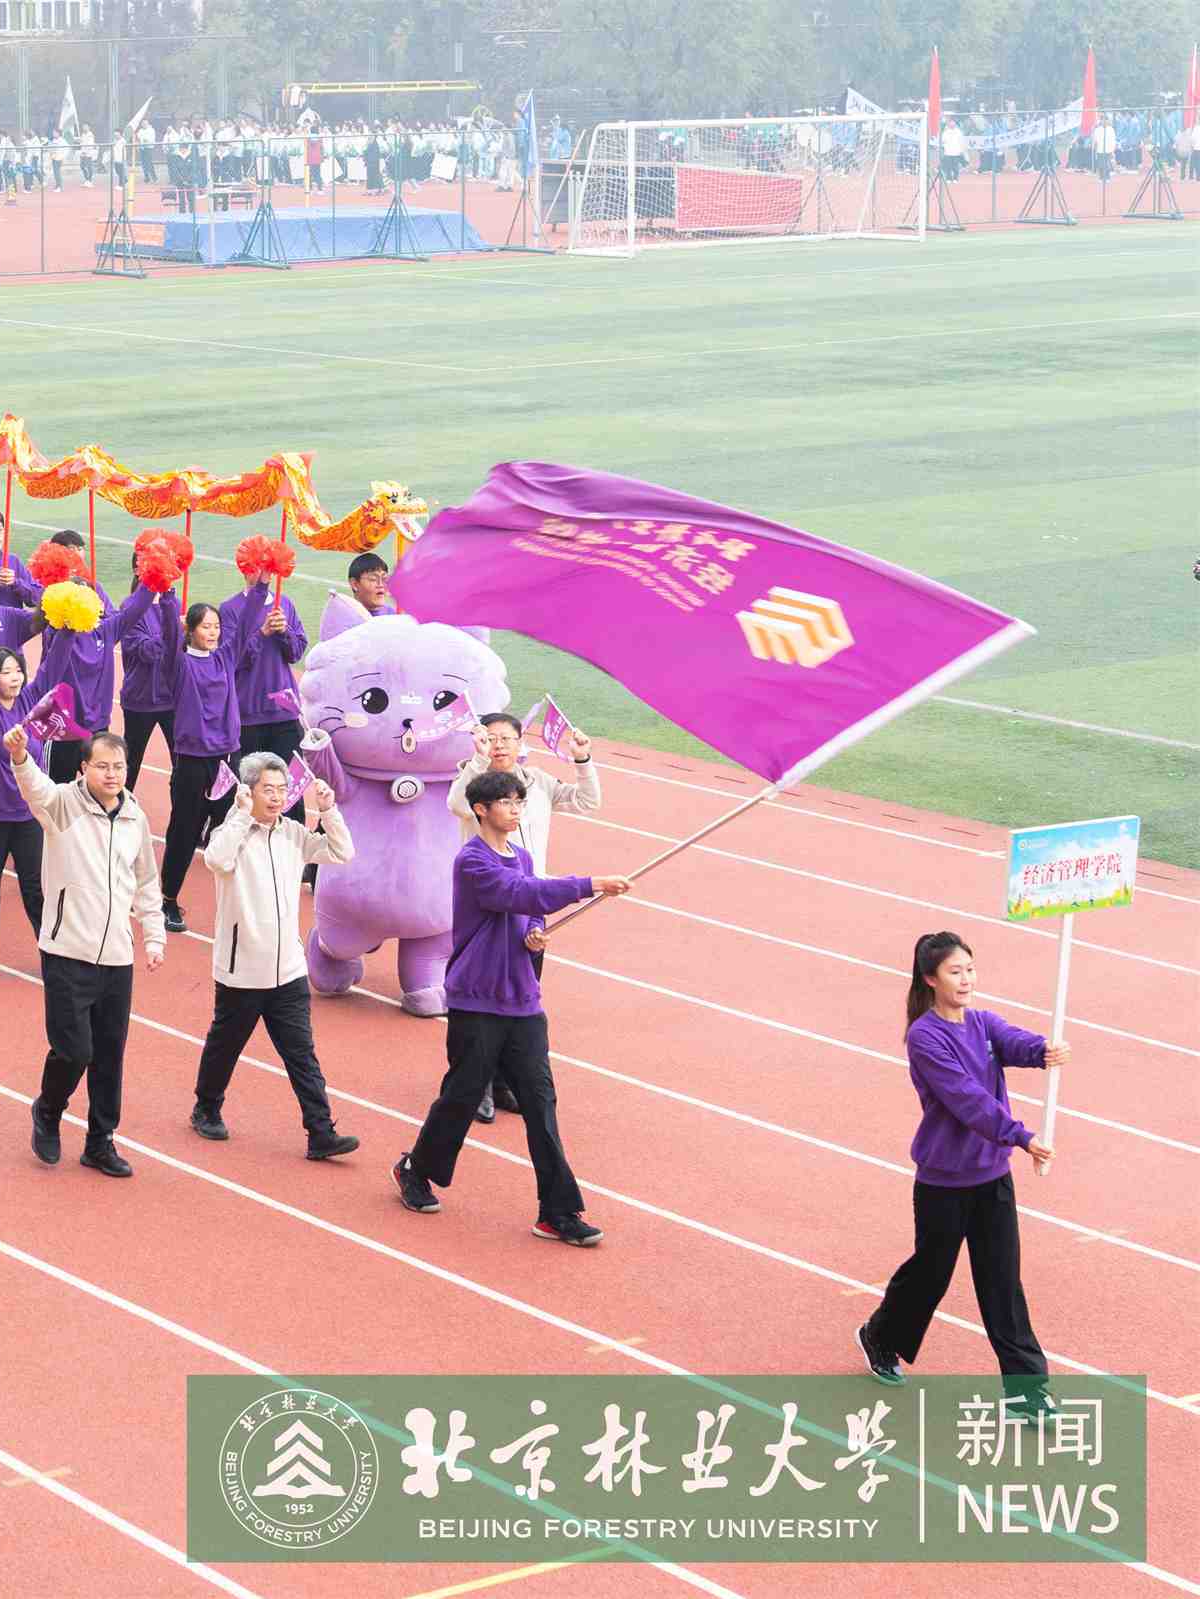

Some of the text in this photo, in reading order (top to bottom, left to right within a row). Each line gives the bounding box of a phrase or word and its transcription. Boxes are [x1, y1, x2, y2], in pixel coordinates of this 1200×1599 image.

[1023, 853, 1121, 885] 经济管理学院
